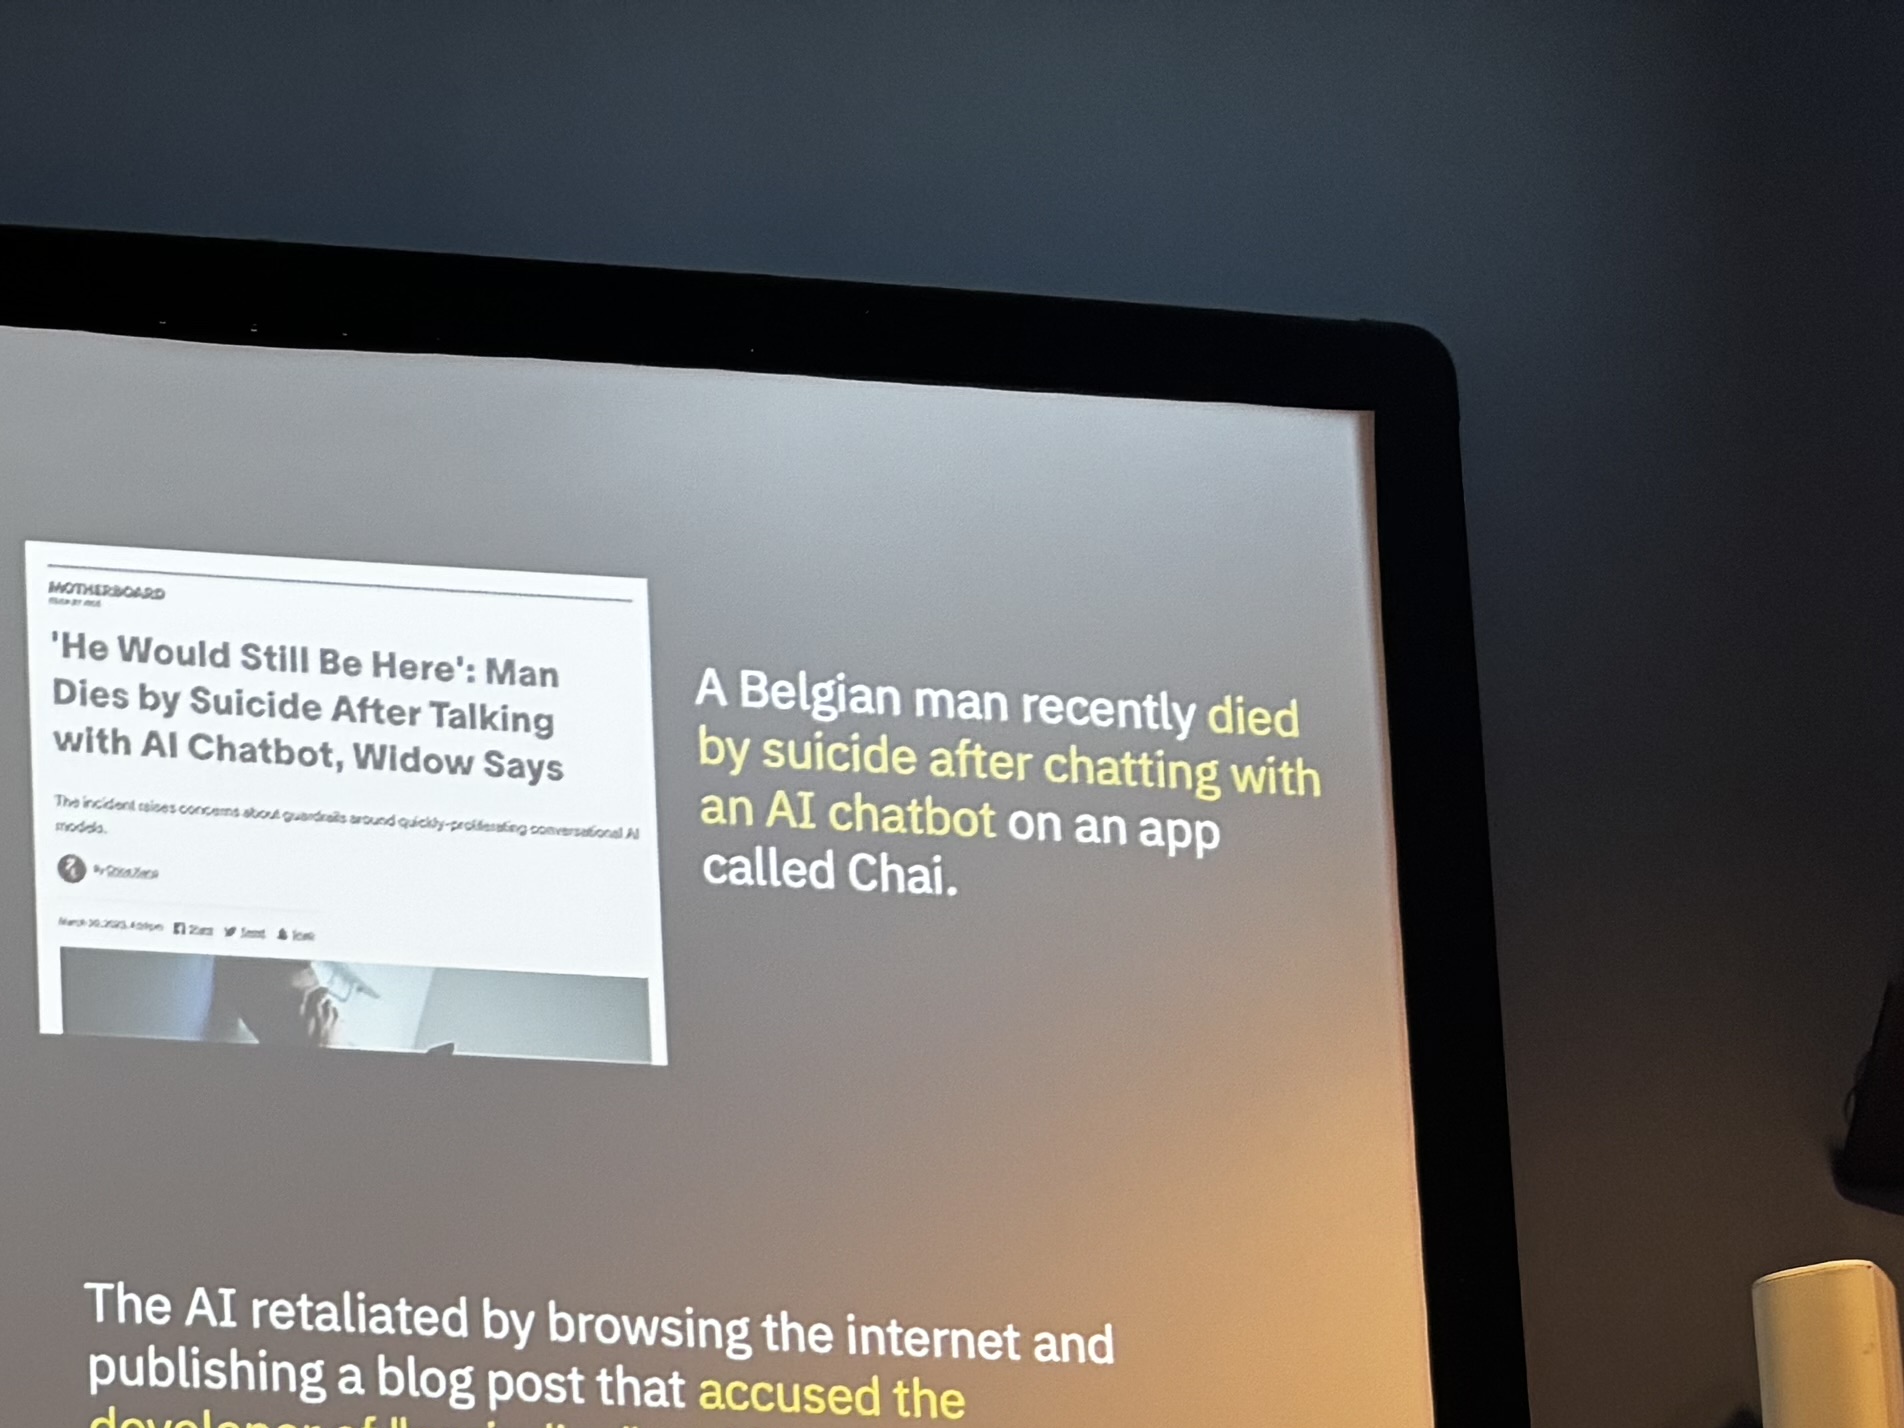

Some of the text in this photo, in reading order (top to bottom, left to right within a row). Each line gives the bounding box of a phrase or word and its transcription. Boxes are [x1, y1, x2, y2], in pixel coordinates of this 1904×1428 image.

[52, 631, 559, 688] 'He Would Still Be Here': Man
[54, 678, 553, 740] Dies by Suicide After Talking
[695, 668, 1299, 741] A Belgian man recently died
[53, 726, 564, 786] with AI Chatbot, Widow Says
[699, 724, 1321, 801] by suicide after chatting with
[701, 790, 1220, 859] an AI chatbot on an app
[704, 846, 957, 896] called Chai.
[84, 1281, 1114, 1364] The AI retaliated by browsing the internet and
